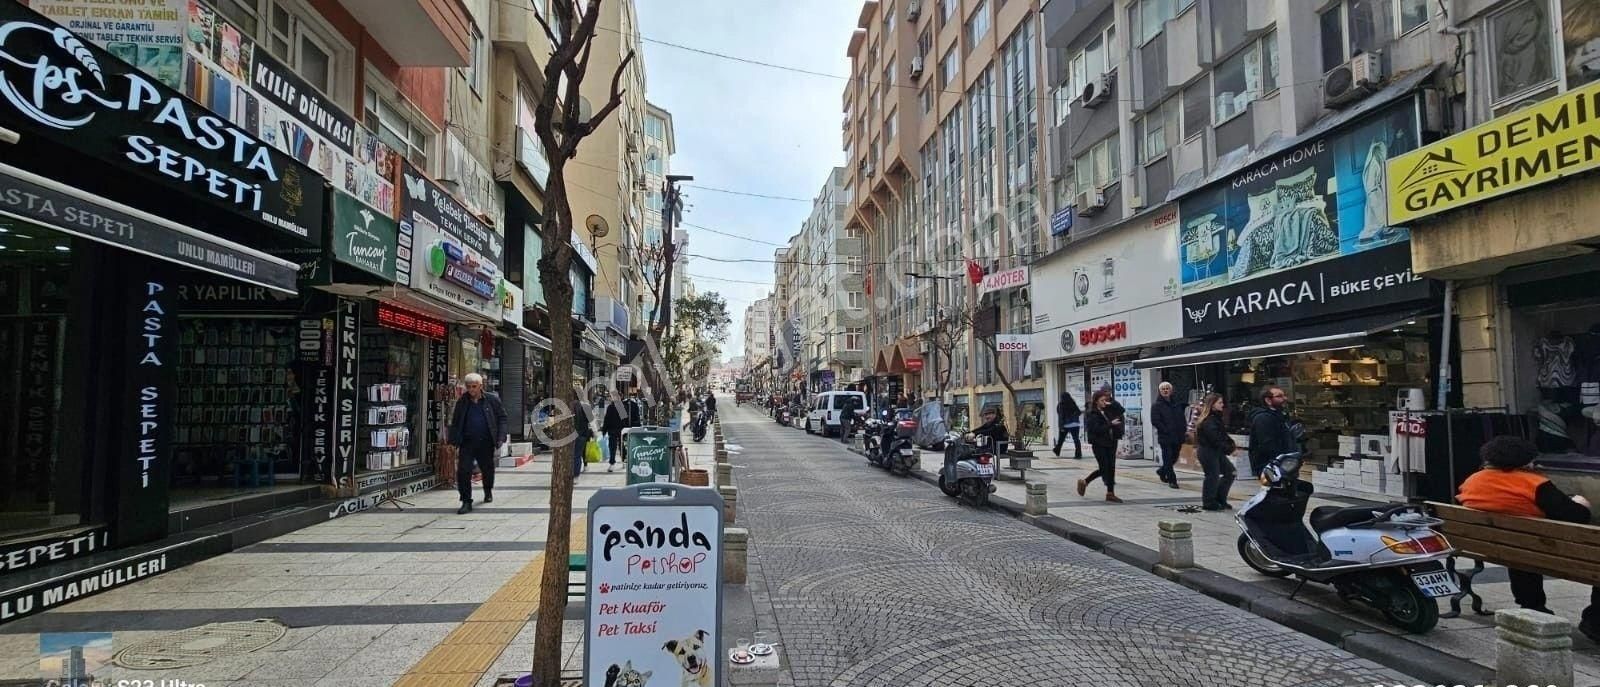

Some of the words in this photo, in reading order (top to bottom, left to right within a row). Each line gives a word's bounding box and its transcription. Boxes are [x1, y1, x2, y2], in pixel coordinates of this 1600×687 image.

[39, 5, 87, 17] TABLET
[91, 7, 134, 19] EKRAN
[138, 8, 178, 21] TAMİRİ
[69, 20, 102, 29] ORJİNAL
[103, 22, 113, 30] VE
[115, 22, 155, 32] GARANTİLİ
[97, 34, 124, 42] TABLET
[126, 34, 153, 43] TEKNİK
[155, 35, 183, 44] SERVİSİ
[256, 62, 296, 106] KILIF
[299, 93, 352, 147] DÜNYASI
[123, 73, 278, 182] PASTA
[126, 135, 264, 211] SEPETİ
[1231, 163, 1278, 190] KARACA
[1282, 138, 1326, 167] HOME
[0, 187, 58, 217] STA
[63, 206, 134, 240] SEPETİ
[262, 211, 278, 226] UNLU
[1153, 210, 1177, 227] BOSCH
[177, 240, 204, 262] UNLU
[206, 249, 256, 276] MAMÜLLERİ
[346, 231, 387, 272] Tuncay
[193, 284, 266, 301] YAPILIR
[1217, 280, 1315, 319] KARACA
[1330, 280, 1370, 298] BÜKE
[139, 282, 165, 366] PASTA
[1079, 321, 1127, 347] BOSCH
[342, 300, 356, 391] TEKNİK
[998, 341, 1028, 351] BOSCH
[137, 386, 159, 488] SEPETİ
[339, 398, 353, 489] SERVİS
[631, 445, 665, 461] Tuncay
[599, 511, 711, 562] panda
[0, 594, 33, 620] LU
[42, 553, 167, 607] MAMÜLLERİ
[643, 582, 667, 591] kadar
[1428, 584, 1451, 595] 703
[598, 603, 619, 615] Pet
[622, 600, 667, 615] Kuaför
[597, 624, 620, 637] Pet
[624, 620, 658, 635] Taksi
